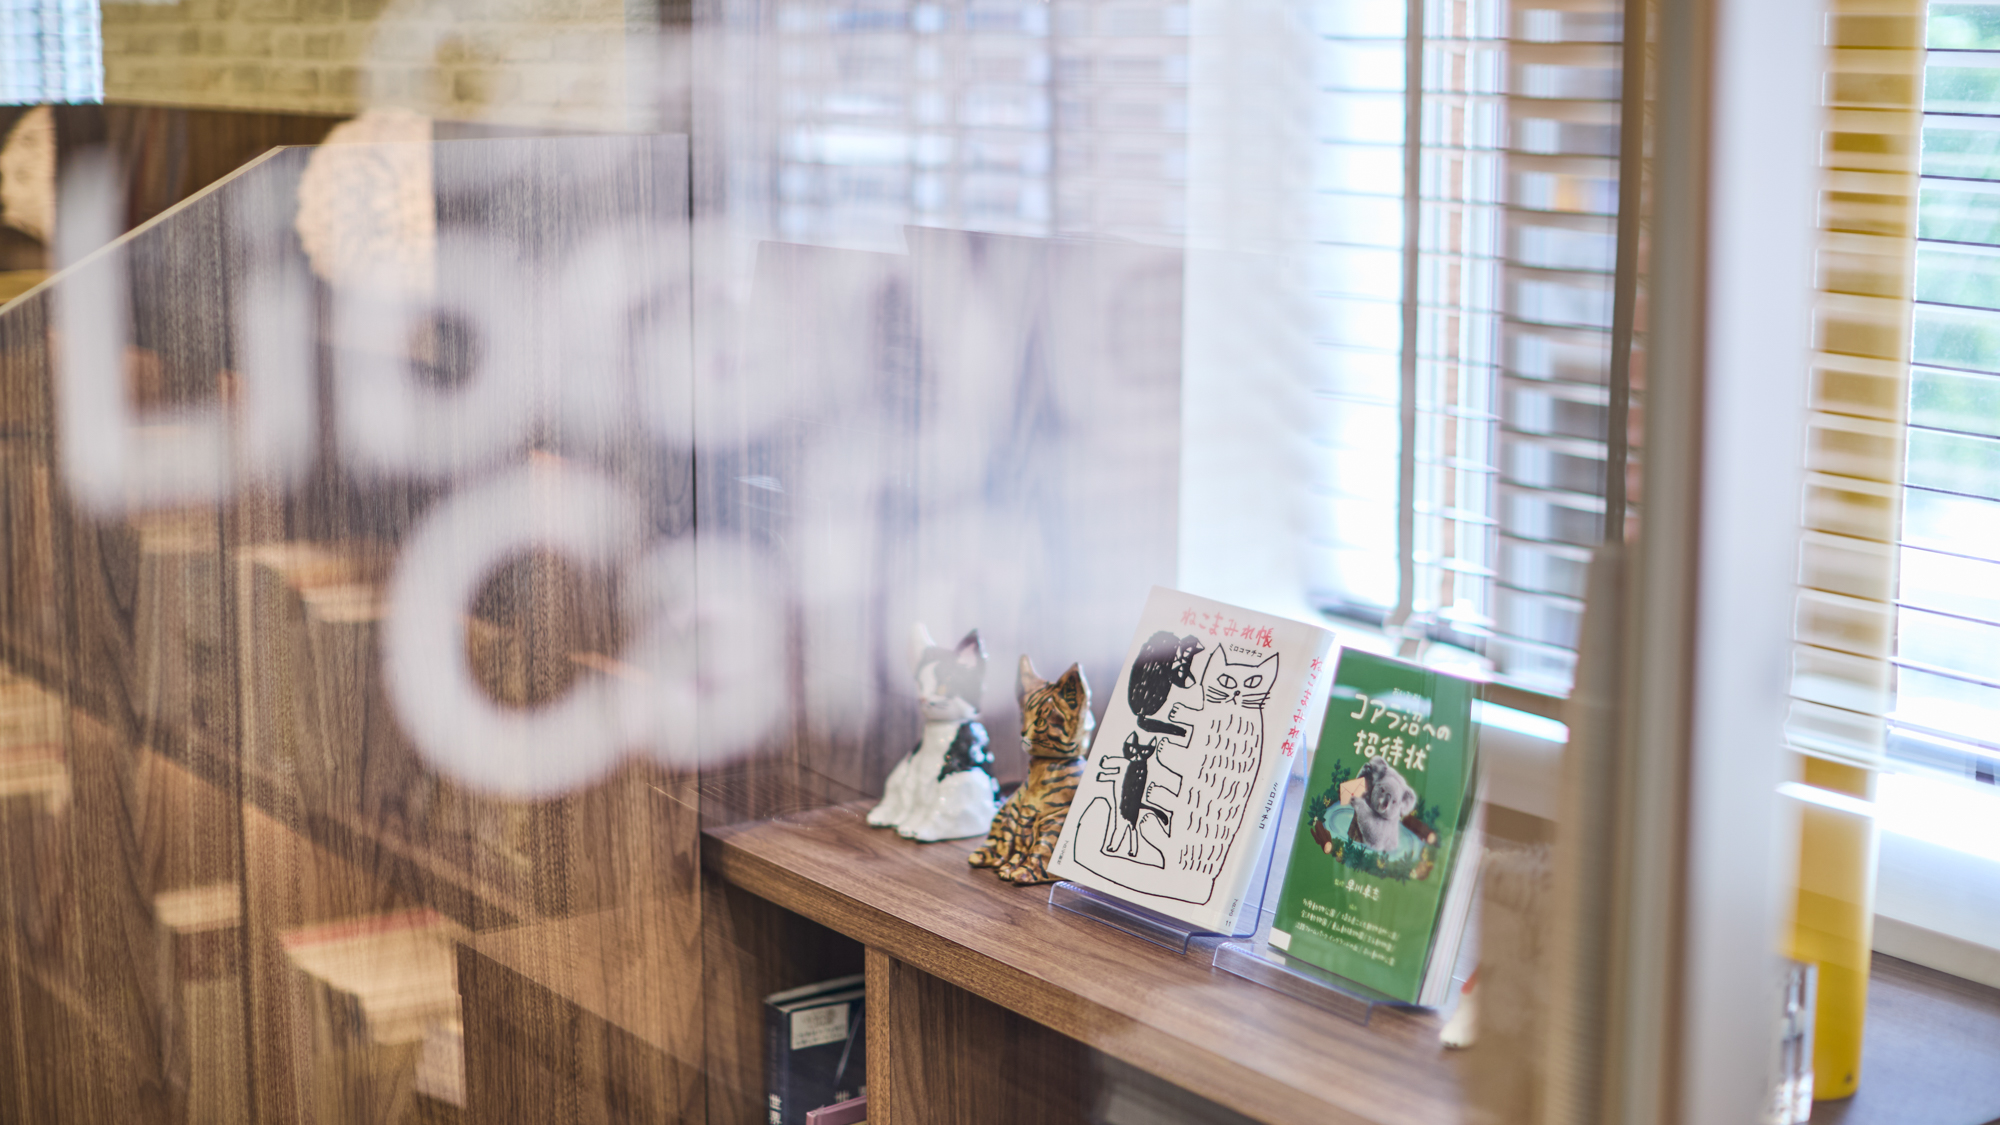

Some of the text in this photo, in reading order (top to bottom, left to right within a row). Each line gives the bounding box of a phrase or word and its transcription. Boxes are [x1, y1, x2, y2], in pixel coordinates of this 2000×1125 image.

[1180, 607, 1274, 649] ねこまみれ帳
[1229, 644, 1263, 658] ミロコマチコ
[1350, 693, 1451, 741] コアラ沼への
[1353, 729, 1432, 772] 招待状
[1258, 782, 1279, 830] ミロコマチコ
